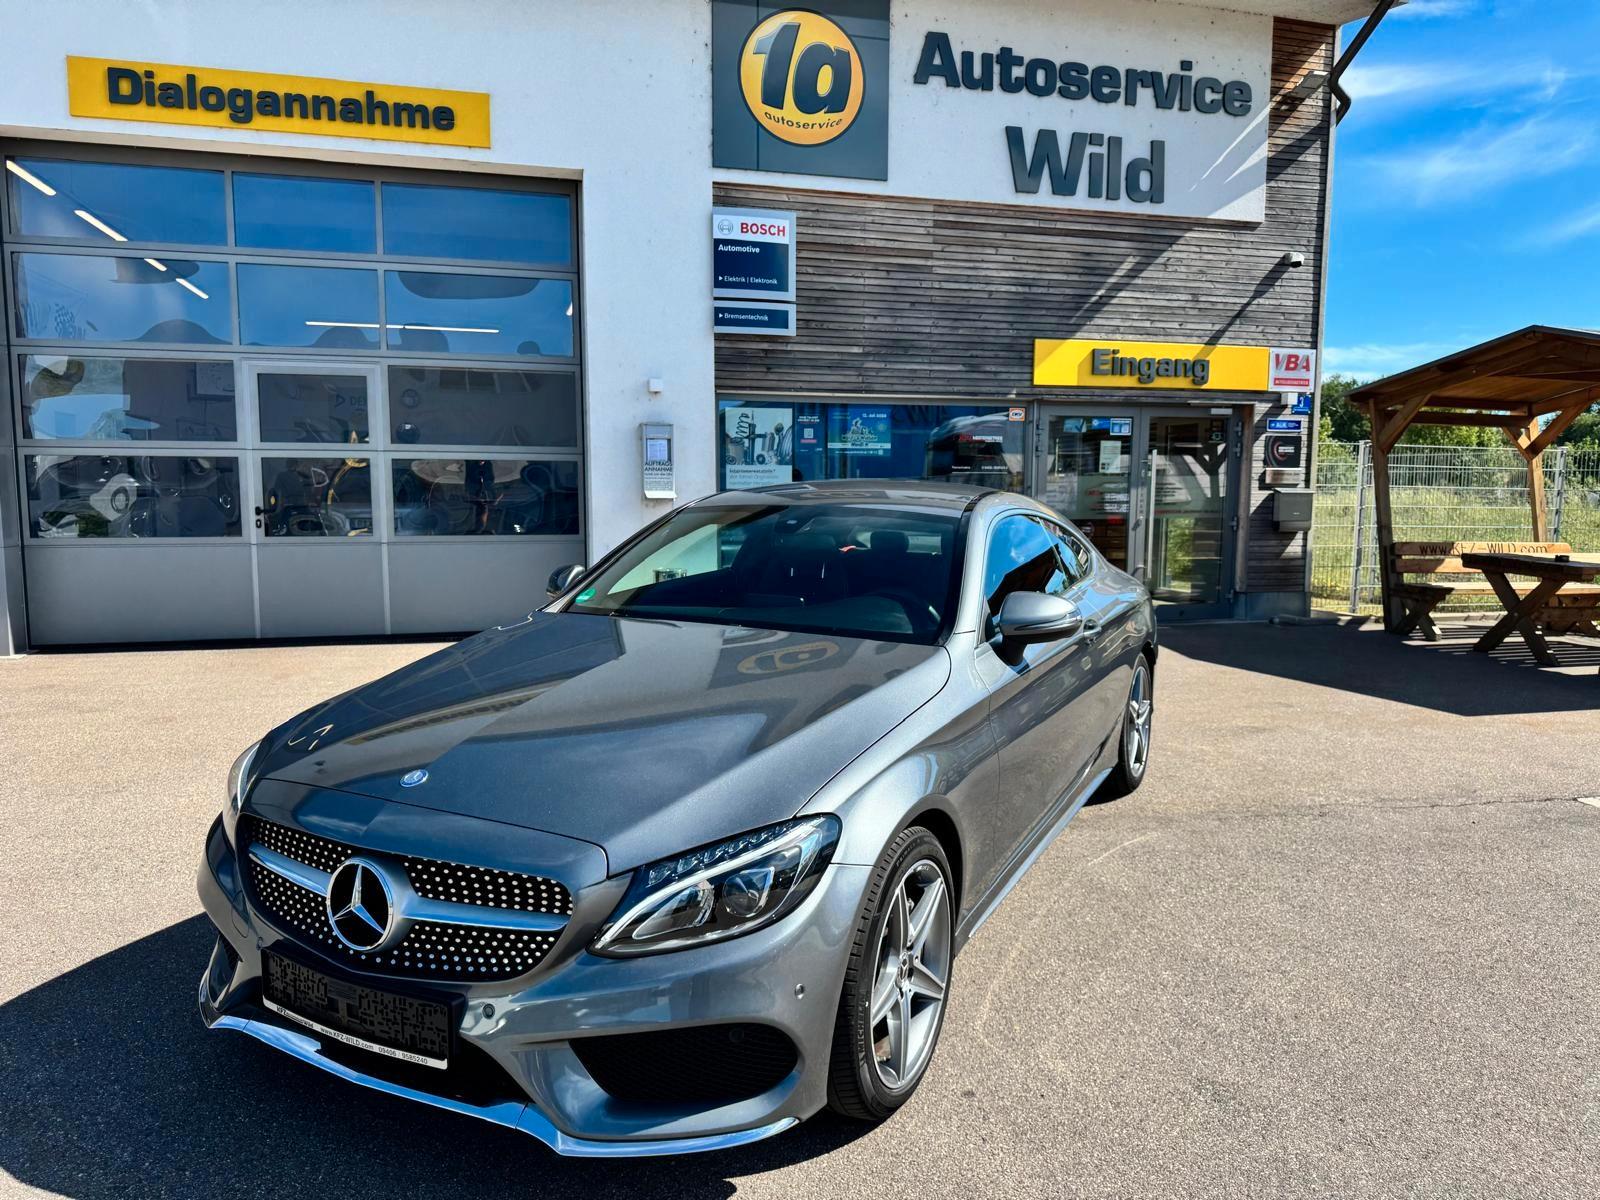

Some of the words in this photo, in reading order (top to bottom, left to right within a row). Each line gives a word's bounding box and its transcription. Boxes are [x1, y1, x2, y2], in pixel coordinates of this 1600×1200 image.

[753, 22, 852, 114] 1a
[913, 31, 1252, 116] Autoservice
[106, 66, 456, 131] Dialogannahme
[764, 111, 842, 129] autoservice
[1005, 125, 1165, 204] Wild
[740, 222, 786, 237] BOSCH
[718, 244, 760, 253] Automotive
[750, 277, 778, 285] Elektronik
[724, 312, 769, 321] Bremsentechnik
[1092, 348, 1210, 385] Eingang
[1274, 353, 1310, 371] VBA
[1299, 397, 1304, 408] 3
[1419, 542, 1548, 554] www.KFZ-WILDcom
[378, 1046, 397, 1058] 09406
[401, 1052, 428, 1065] 9585240
